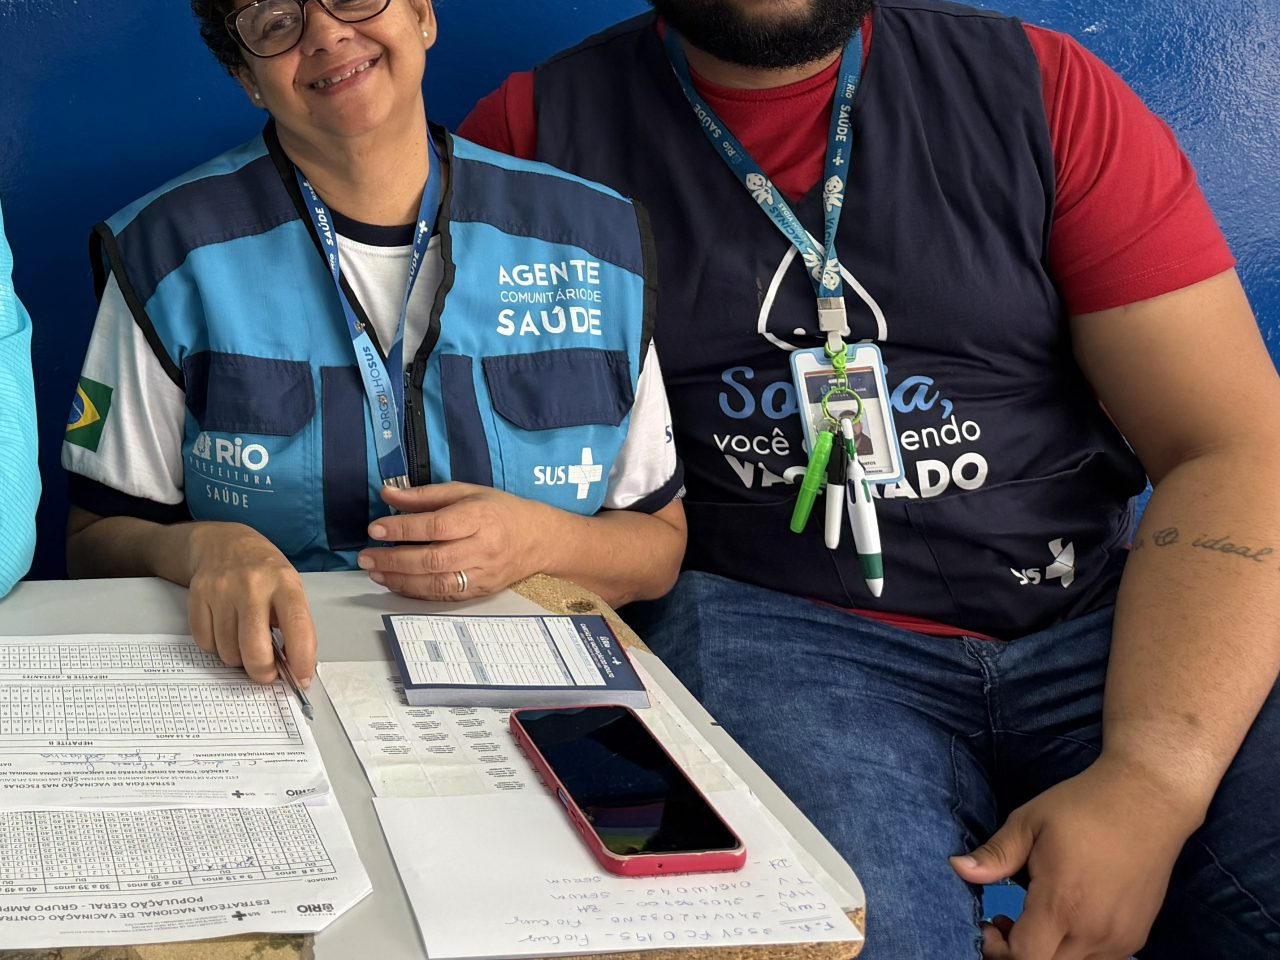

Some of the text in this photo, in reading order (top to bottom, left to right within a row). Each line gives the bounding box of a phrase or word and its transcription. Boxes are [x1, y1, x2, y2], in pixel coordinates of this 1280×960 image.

[693, 104, 722, 138] SAÚDE
[835, 104, 852, 143] SAÚDE
[315, 206, 335, 247] SAÚDE
[769, 206, 804, 246] VACINAS
[498, 259, 600, 287] AGENTE
[496, 305, 602, 337] SAÚDE
[215, 437, 269, 471] Rio
[713, 427, 790, 456] você
[189, 455, 272, 485] PREFEITURA
[533, 465, 566, 486] SUS
[206, 485, 249, 508] SAÚDE
[1191, 534, 1273, 562] ideal
[34, 903, 78, 912] GRUPO
[88, 902, 127, 910] GERAL
[131, 895, 204, 909] POPULAÇÃO
[138, 906, 196, 918] NACIONAL
[198, 899, 271, 913] ESTRATÉGIA
[297, 903, 322, 914] RIO
[48, 911, 117, 921] VACINAÇÃO
[119, 911, 135, 919] DE
